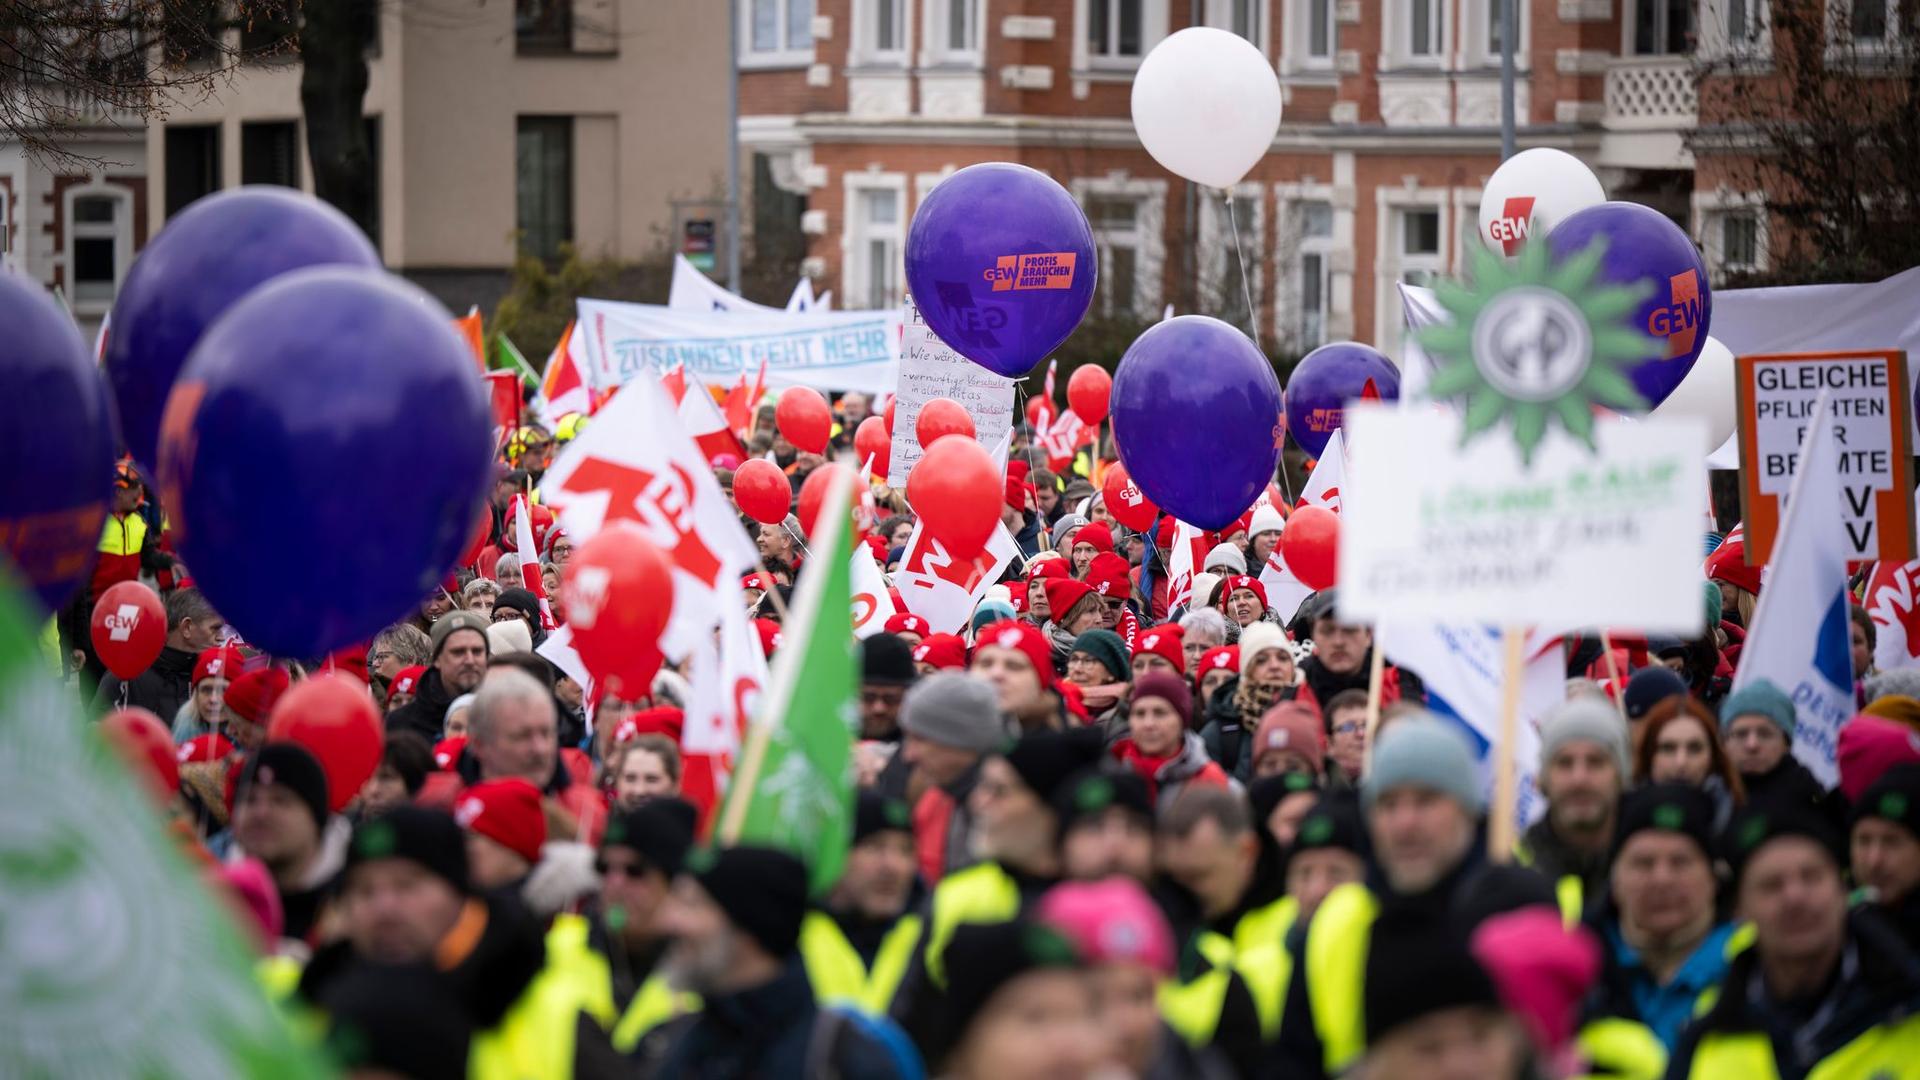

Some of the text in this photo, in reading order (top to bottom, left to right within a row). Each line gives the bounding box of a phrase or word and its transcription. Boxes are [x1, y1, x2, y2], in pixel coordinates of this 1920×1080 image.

[1489, 216, 1536, 241] GEW
[1024, 256, 1058, 267] PROFIS
[983, 266, 1018, 281] GEW
[1022, 266, 1070, 277] BRAUCHEN
[1019, 276, 1048, 287] MEHR
[1648, 296, 1703, 337] GEW
[616, 342, 744, 373] ZUSAMMEN
[750, 339, 811, 366] GEHT
[822, 329, 887, 358] MEHR
[910, 346, 930, 360] Wie
[1757, 364, 1888, 391] GLEICHE
[1797, 426, 1848, 446] FR
[1766, 450, 1888, 477] BEMTE
[104, 613, 140, 632] GEW
